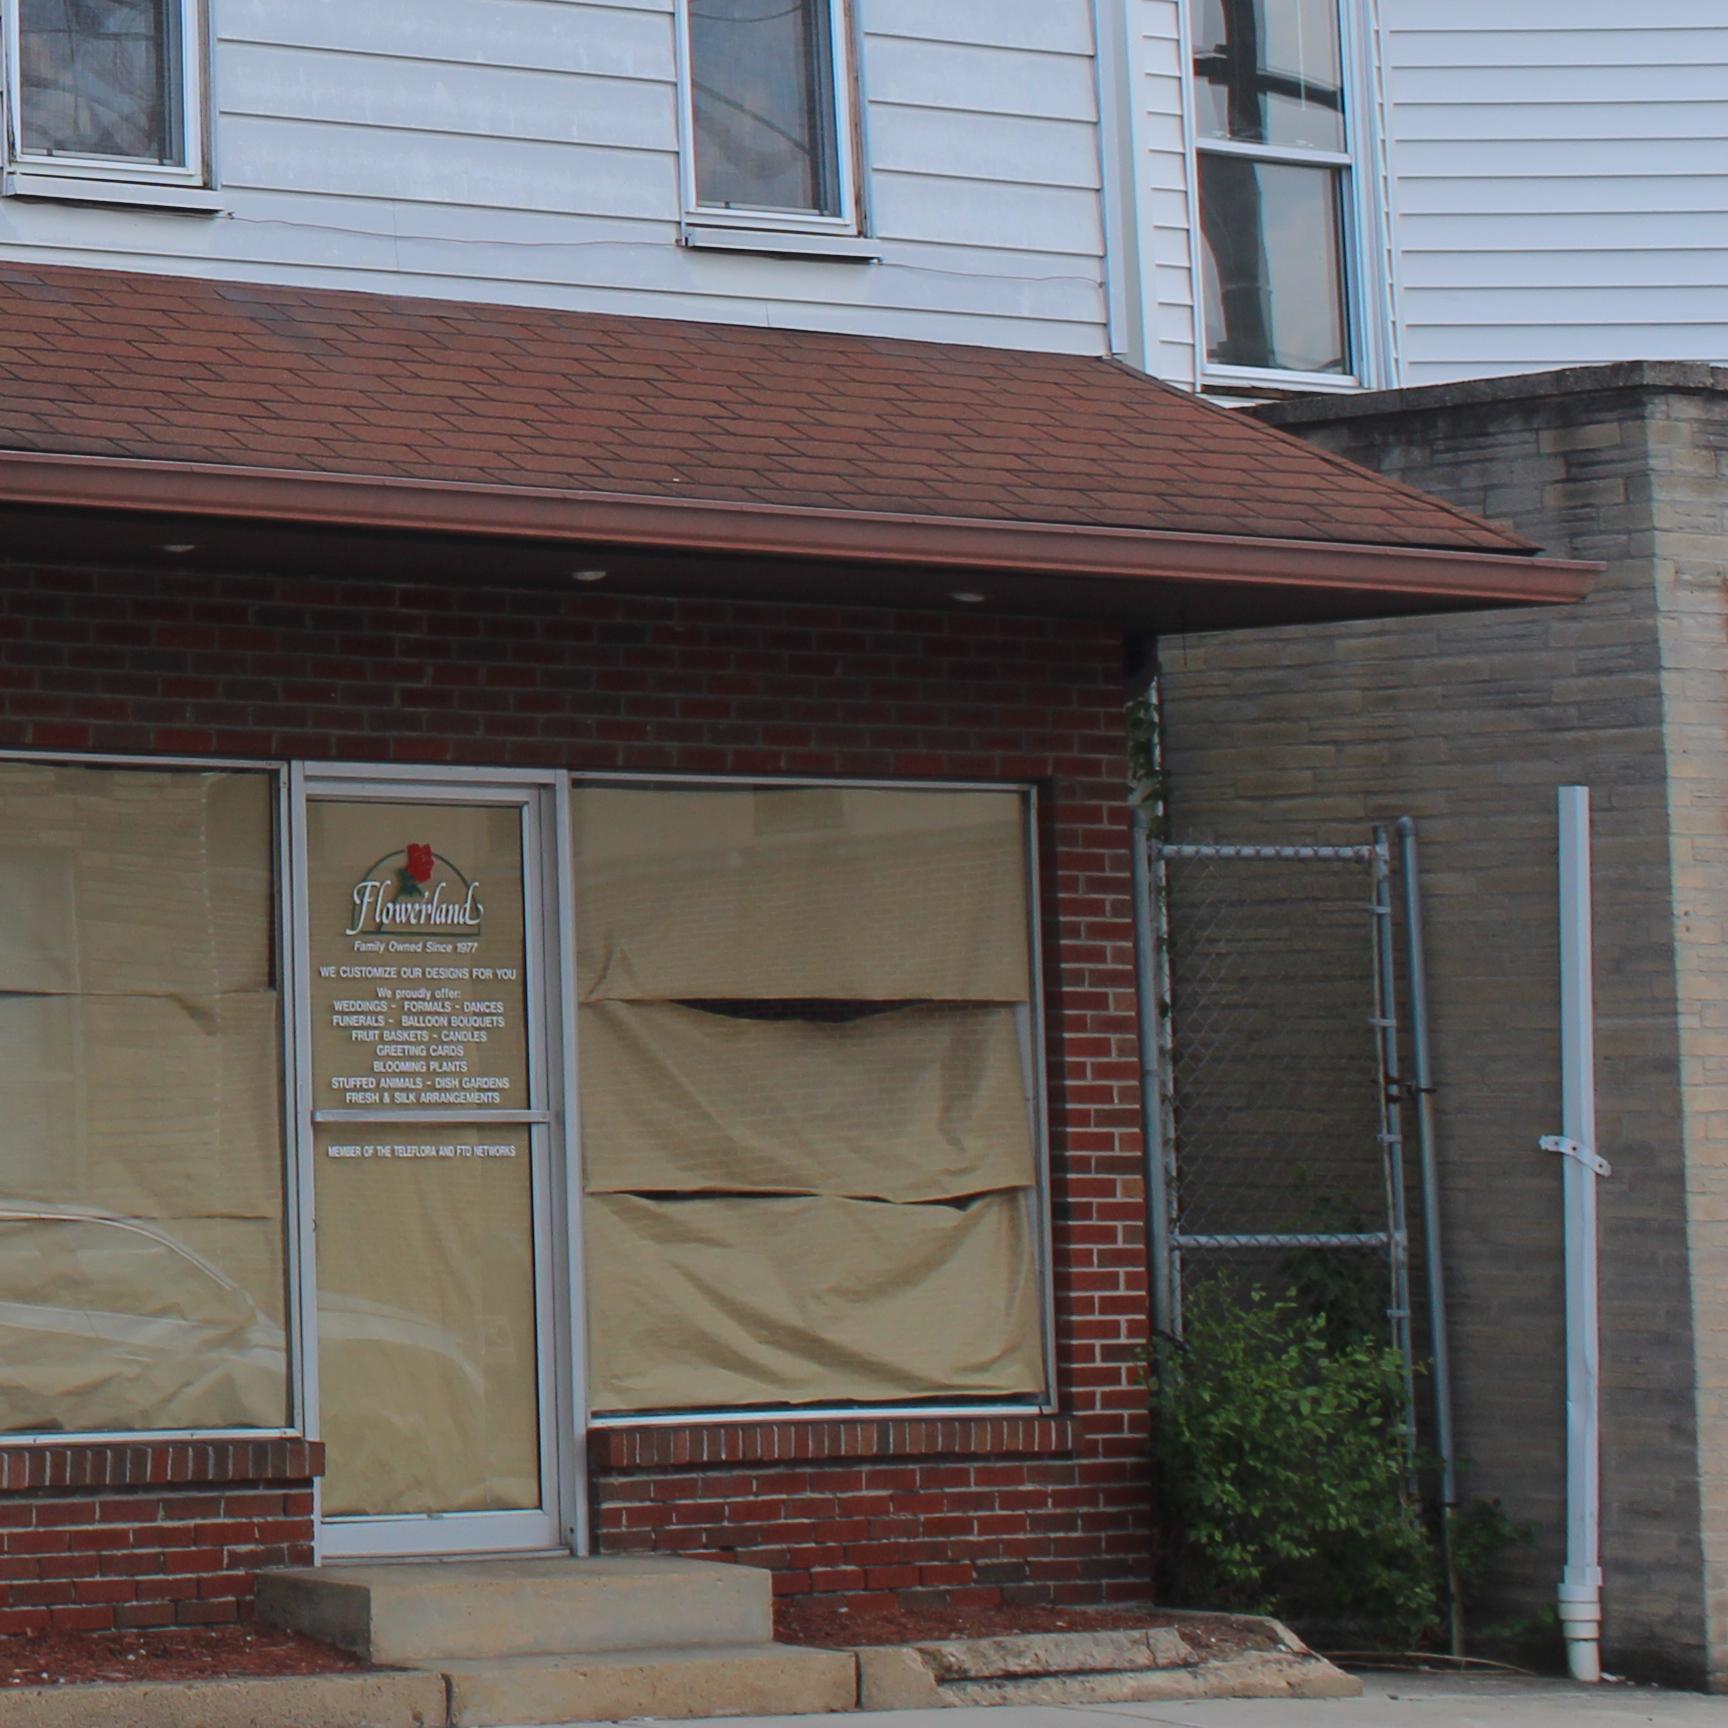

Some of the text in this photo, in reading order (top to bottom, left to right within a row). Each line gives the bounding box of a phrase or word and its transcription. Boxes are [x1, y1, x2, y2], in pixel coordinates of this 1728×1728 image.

[345, 880, 484, 936] Flowerland
[353, 941, 479, 954] Family Owned Since 1977
[319, 966, 516, 980] WE CUSTOMIZE OUR DESIGNS FOR YOU
[376, 987, 461, 1000] We proudly offer:
[333, 1000, 387, 1012] WEDDINGS
[404, 1001, 451, 1012] FORMALS
[464, 1002, 504, 1013] DANCES
[333, 1015, 385, 1026] FUNERALS
[401, 1016, 447, 1027] BALLOON
[451, 1016, 505, 1028] BOUQUETS
[352, 1030, 379, 1041] FRUIT
[383, 1031, 429, 1042] BASKETS
[441, 1031, 487, 1042] CANDLES
[376, 1045, 464, 1057] GREETING CARDS
[373, 1061, 468, 1072] BLOOMING PLANTS
[331, 1077, 376, 1088] STUFFED
[379, 1077, 423, 1089] ANIMALS
[435, 1077, 459, 1089] DISH
[462, 1078, 510, 1089] GARDENS
[346, 1092, 500, 1103] FRESH & SILK ARRANGEMENTS
[327, 1145, 516, 1158] MEMBER OF THE TELEFLORA AND FTD NETWORKS
